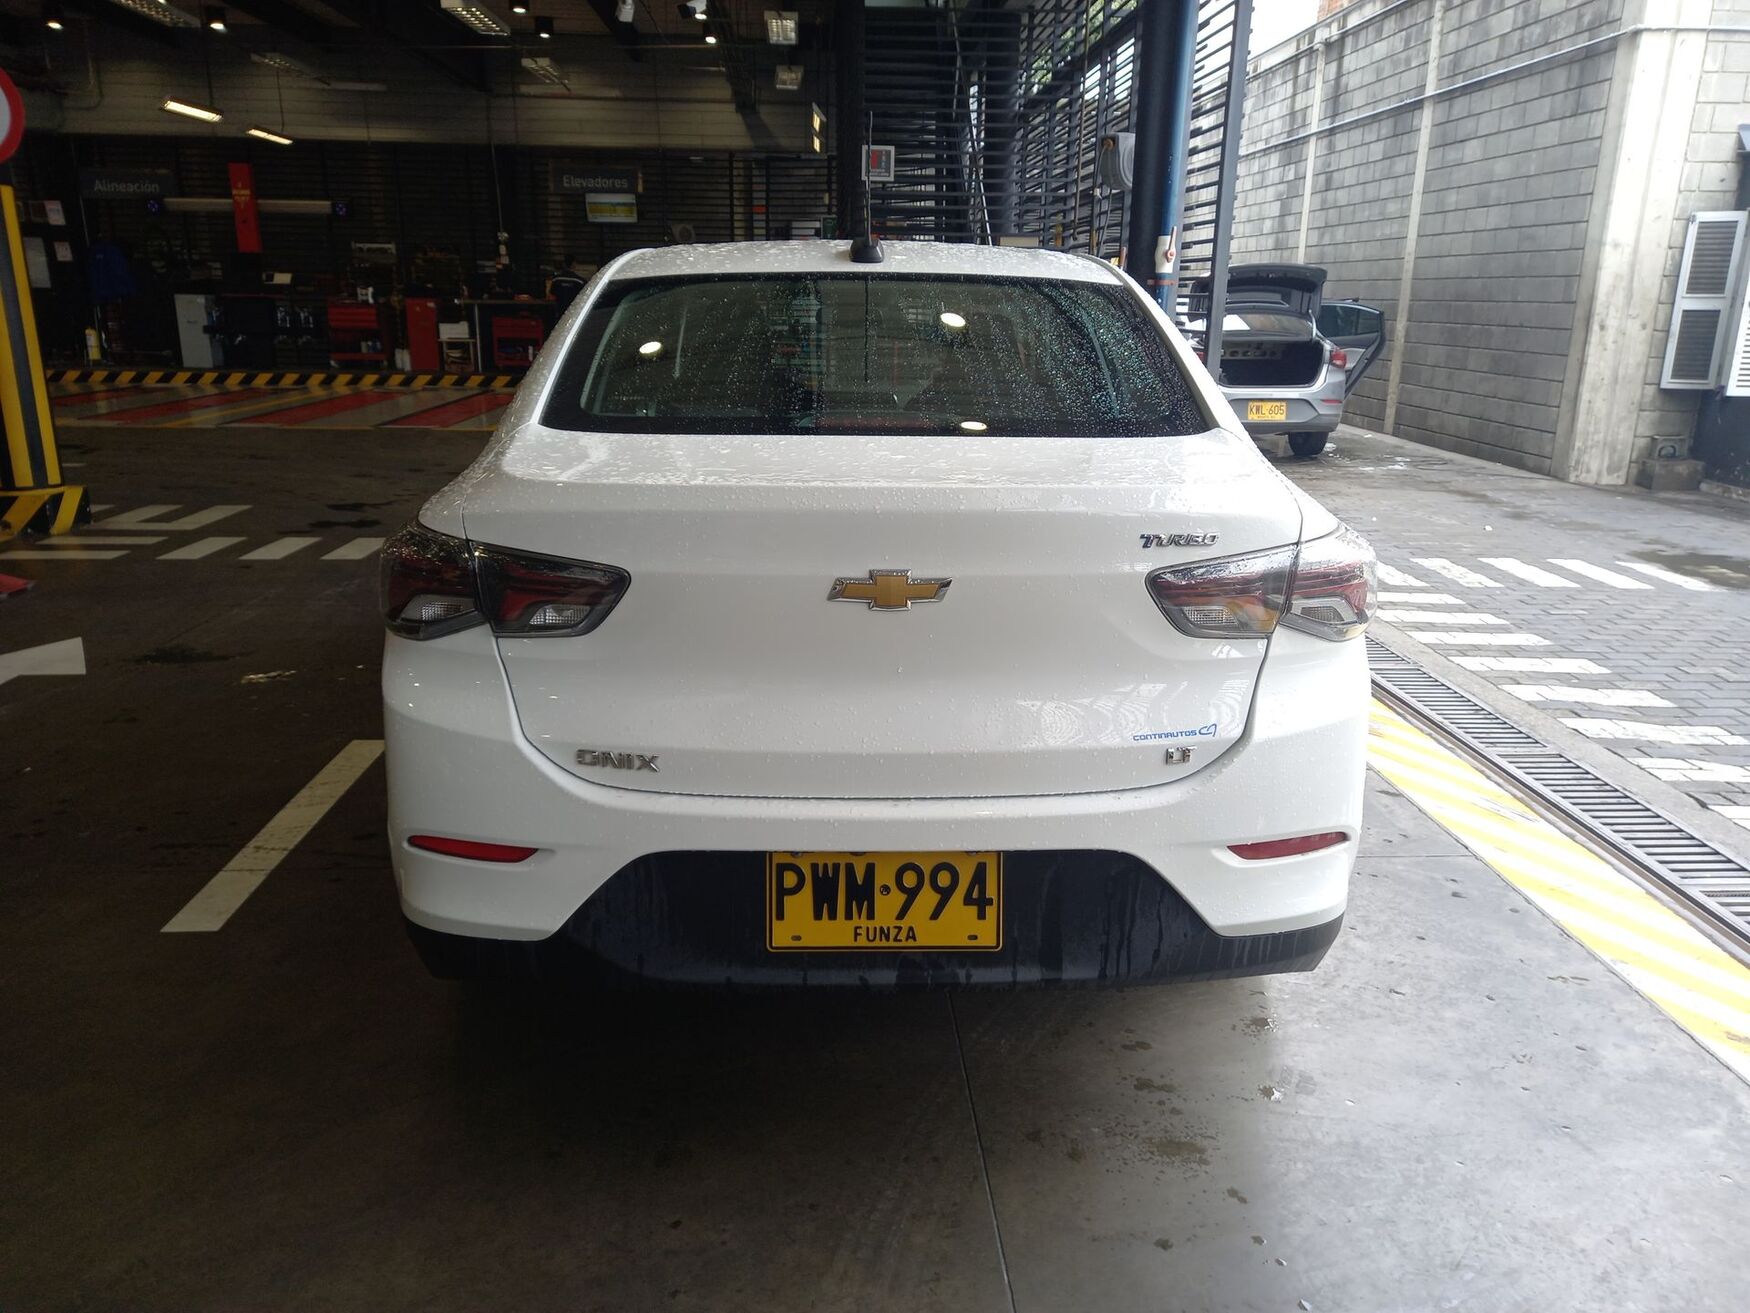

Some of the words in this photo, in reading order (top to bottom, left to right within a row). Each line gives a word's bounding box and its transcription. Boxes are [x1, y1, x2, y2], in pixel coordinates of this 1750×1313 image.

[94, 179, 160, 193] Alineación
[562, 174, 629, 189] Elevadores
[1140, 532, 1219, 549] TURBO
[1132, 729, 1197, 741] CONTINAUTOS
[576, 749, 660, 773] ONIX
[1166, 745, 1197, 765] LT
[853, 925, 918, 943] FUNZA
